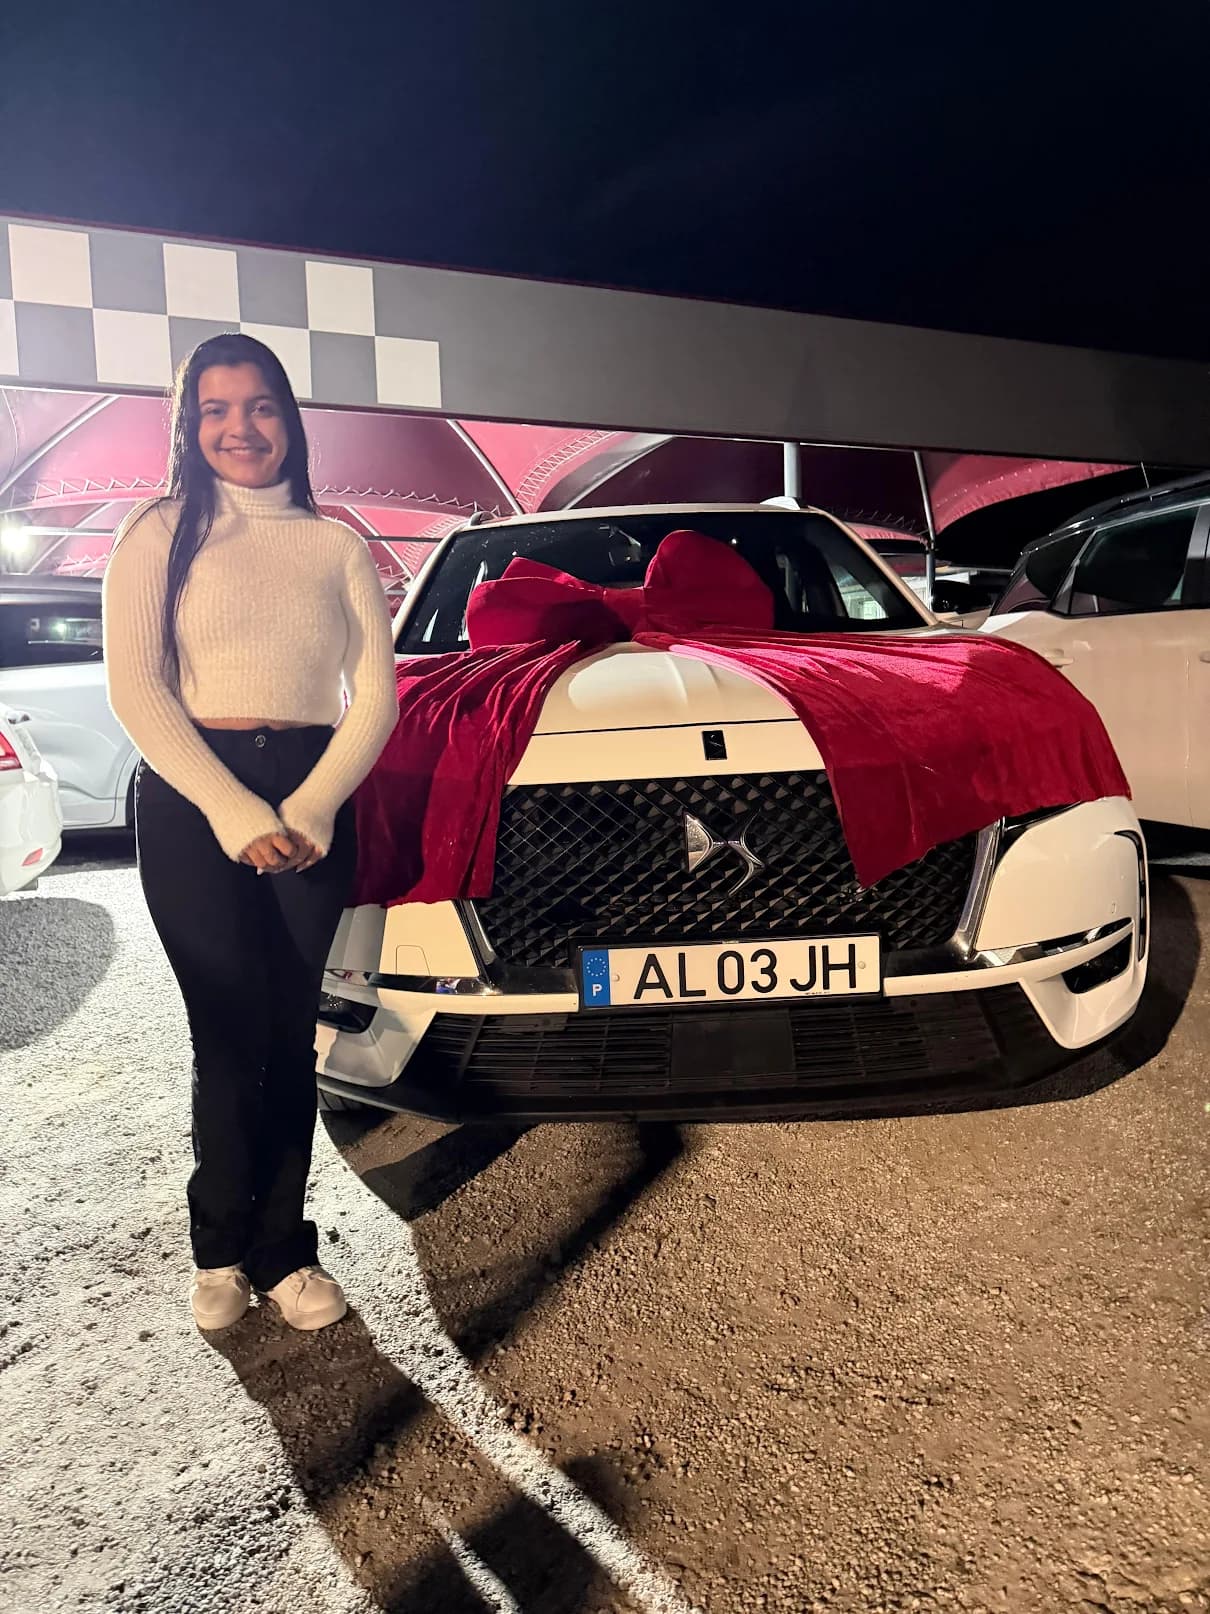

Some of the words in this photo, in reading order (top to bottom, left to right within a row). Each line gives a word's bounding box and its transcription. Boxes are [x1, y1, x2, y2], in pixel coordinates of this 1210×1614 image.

[633, 952, 706, 999] AL
[717, 948, 778, 995] 03
[789, 943, 857, 991] JH
[592, 984, 603, 997] P
